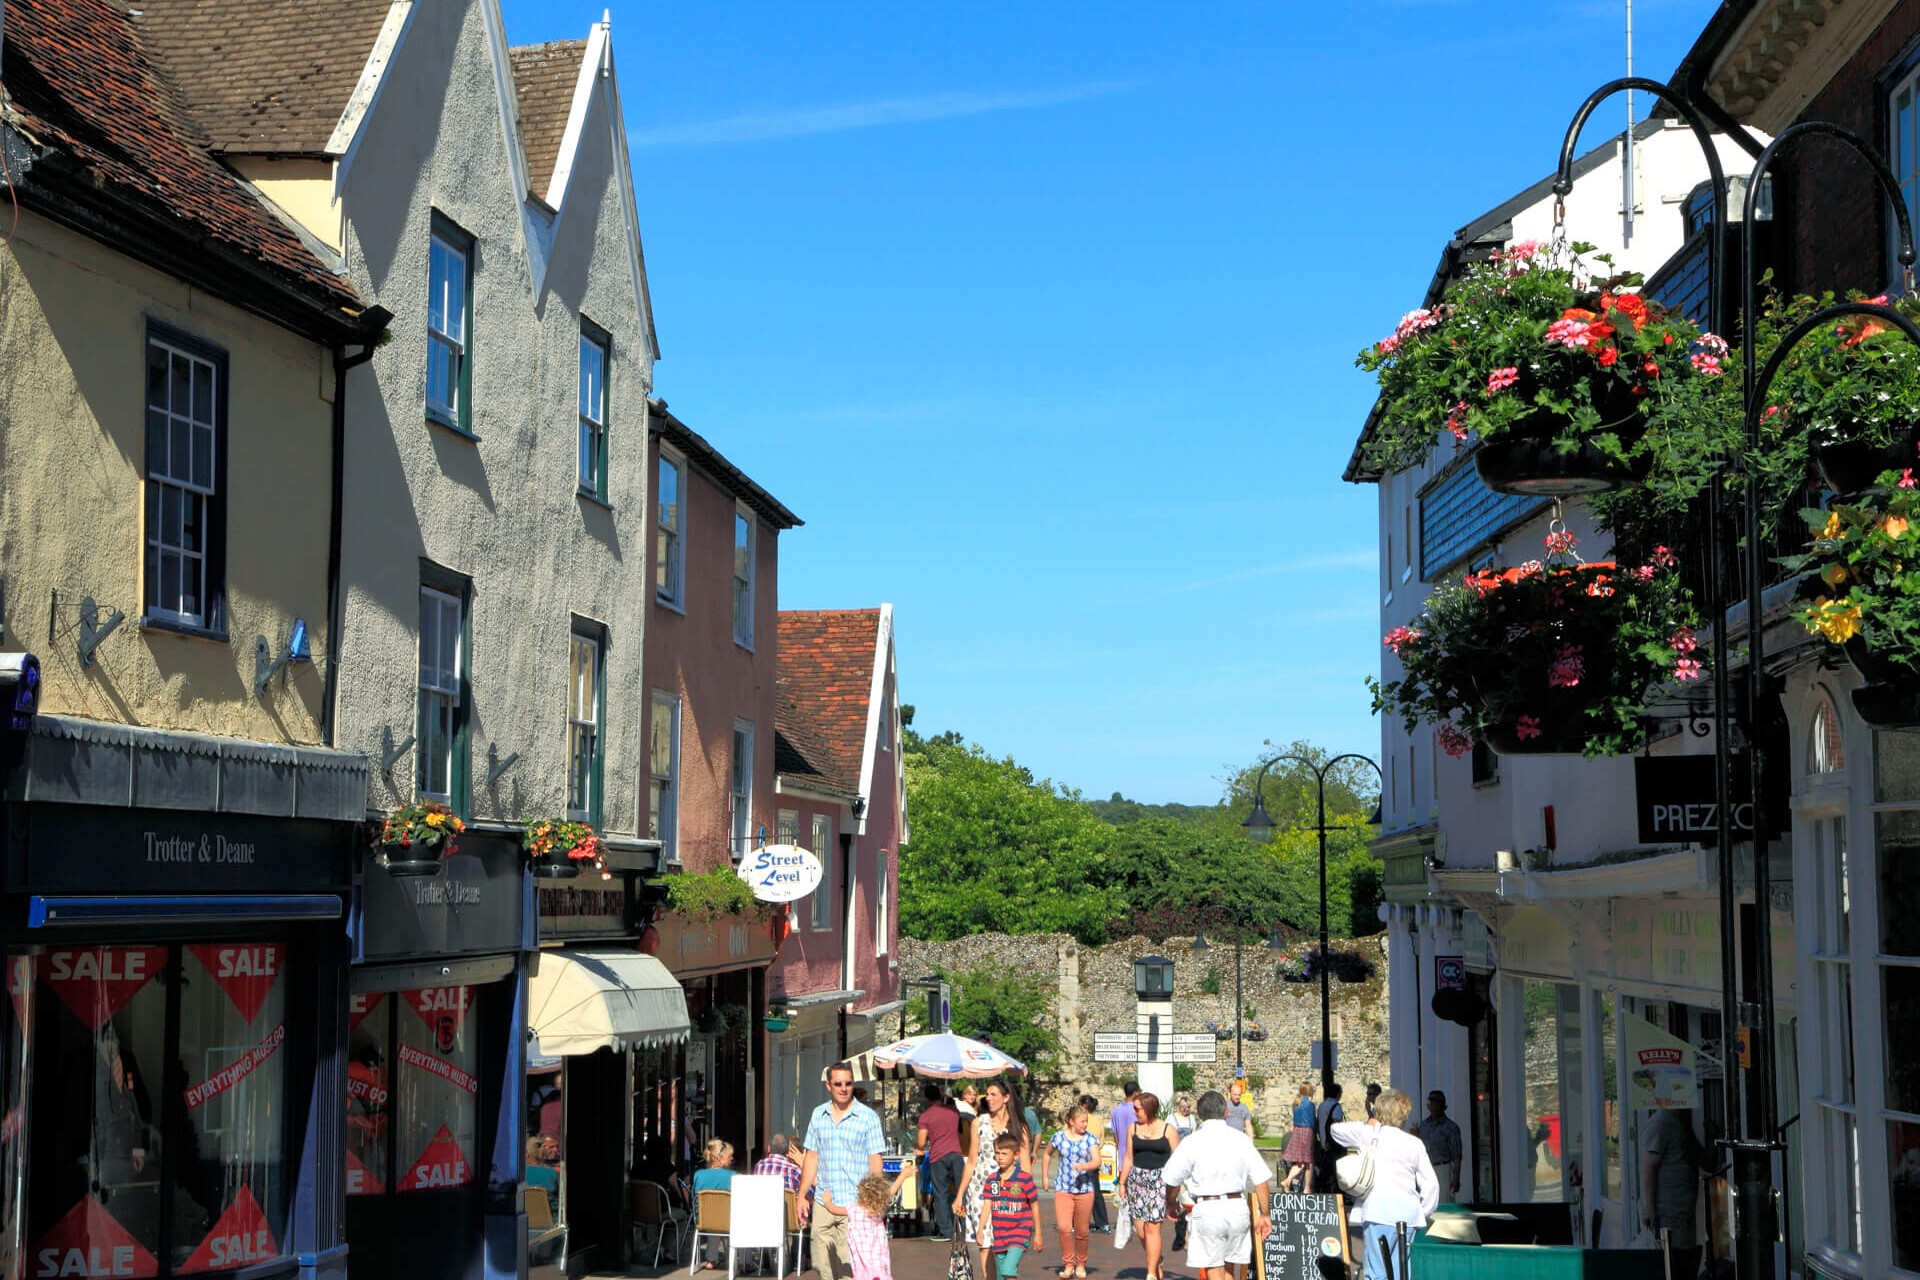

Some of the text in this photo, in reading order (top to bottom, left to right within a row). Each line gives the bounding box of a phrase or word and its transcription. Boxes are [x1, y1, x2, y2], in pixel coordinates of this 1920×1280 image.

[144, 832, 256, 863] Trotter & Deane
[755, 853, 804, 874] Street
[760, 870, 800, 886] Level
[415, 880, 442, 904] Trotter
[455, 880, 481, 904] Deane
[50, 952, 146, 980] SALE
[218, 949, 275, 978] SALE
[419, 987, 468, 1011] SALE
[187, 1024, 286, 1106] EVERYTHING MUST GO
[1641, 1049, 1680, 1061] KELLY'S
[399, 1045, 477, 1092] EVERYTHING MUST GO
[347, 1078, 388, 1103] UST GO
[415, 1161, 464, 1189] SALE
[991, 1182, 999, 1195] 3
[1273, 1193, 1326, 1211] CORNISH
[1294, 1211, 1306, 1223] ICE
[1309, 1212, 1339, 1226] CREAM
[208, 1230, 268, 1267] SALE
[1265, 1251, 1288, 1265] Large
[37, 1245, 134, 1278] SALE
[1265, 1263, 1285, 1276] Huge
